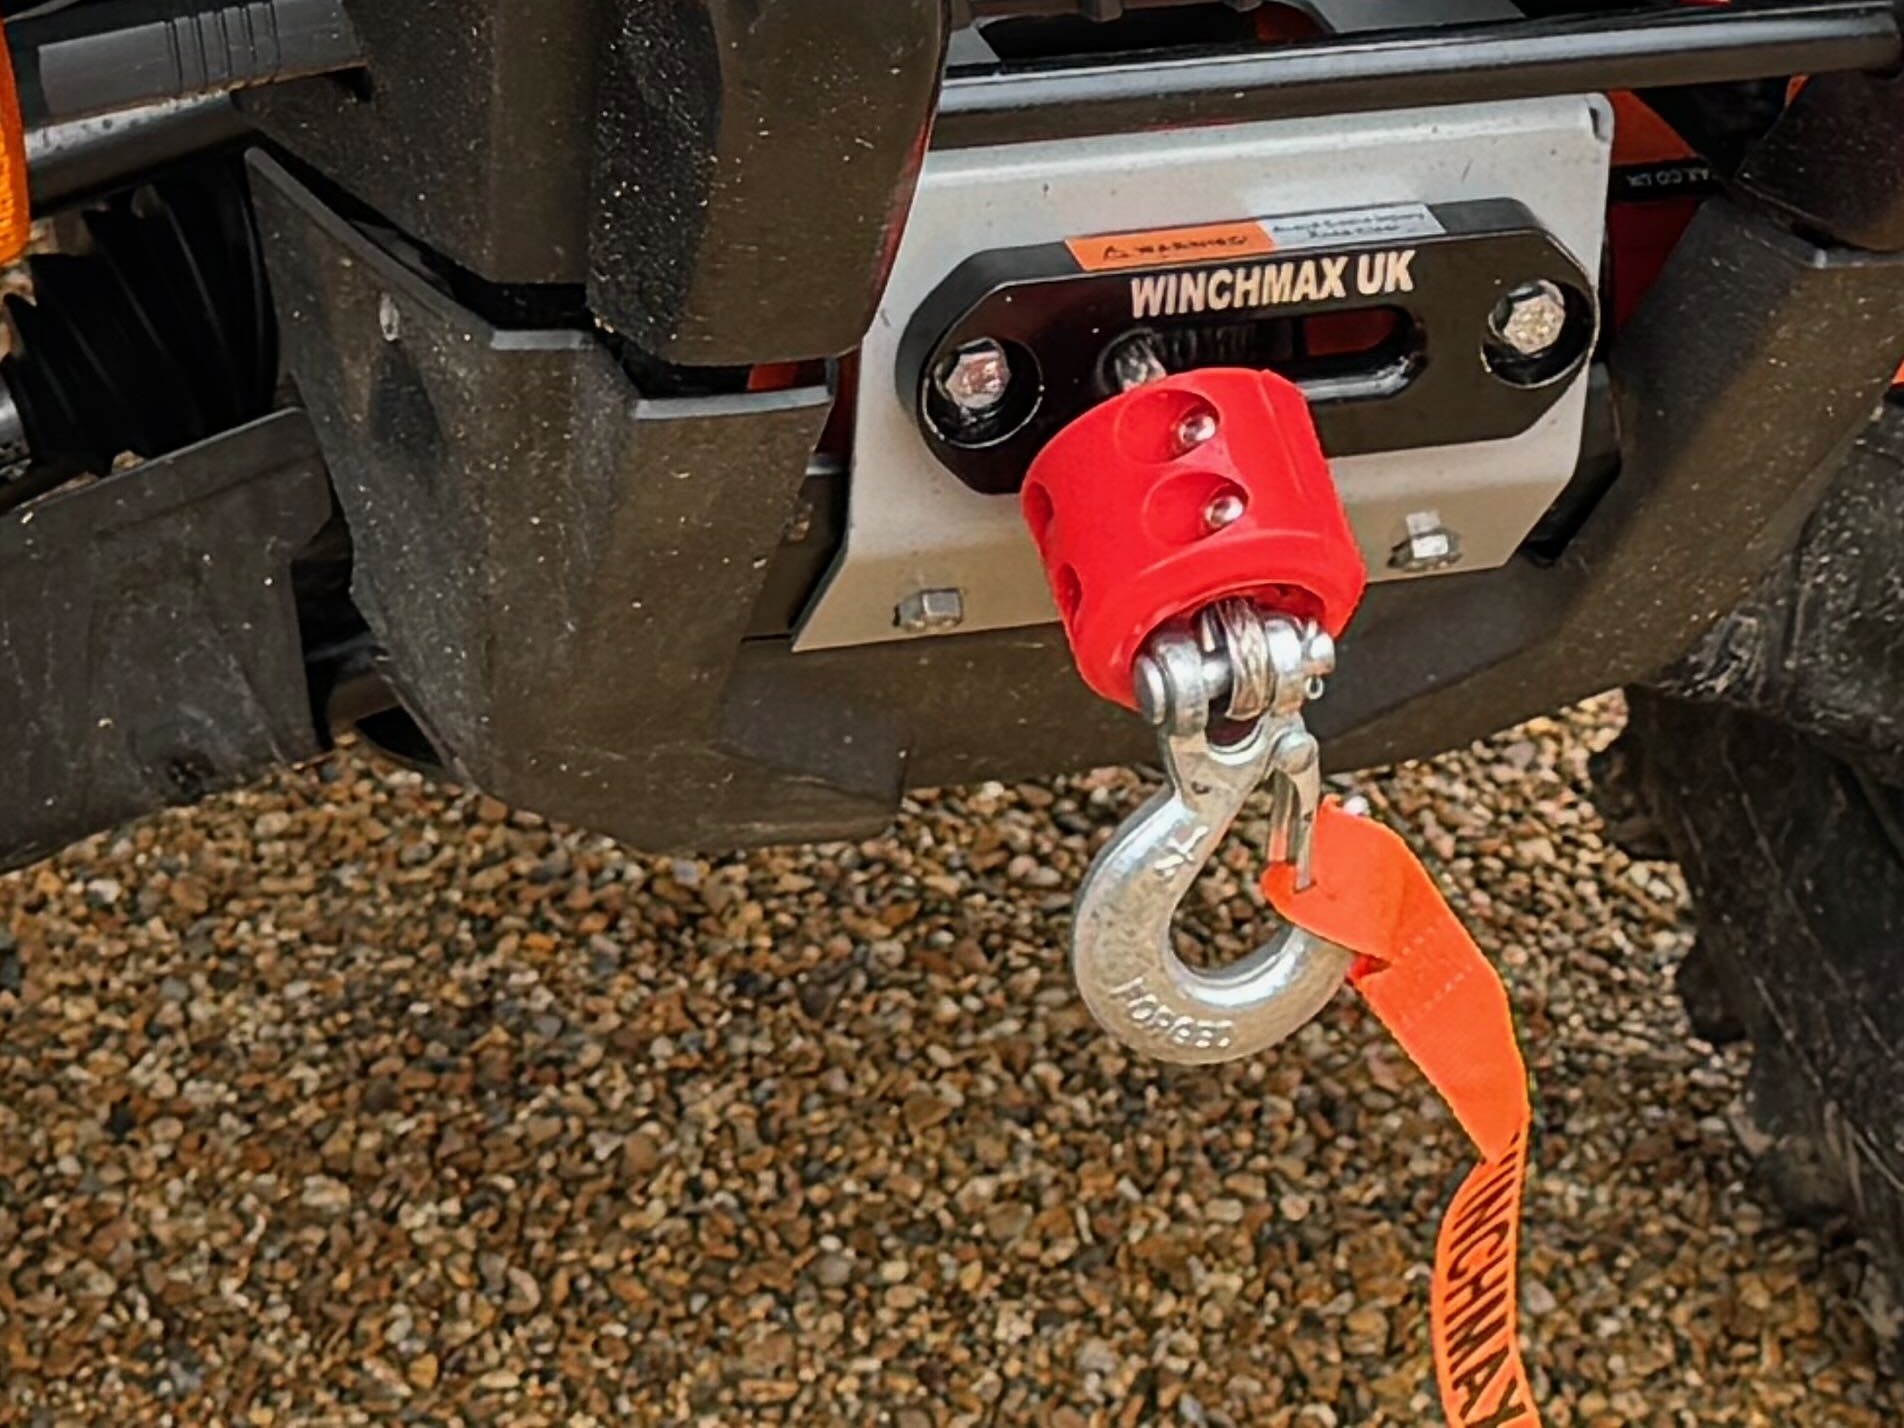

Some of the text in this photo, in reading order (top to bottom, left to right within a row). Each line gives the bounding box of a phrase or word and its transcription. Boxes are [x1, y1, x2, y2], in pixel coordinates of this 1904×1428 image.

[1130, 249, 1417, 319] WINCHMAX UK
[1444, 1130, 1528, 1428] INCHMAX
